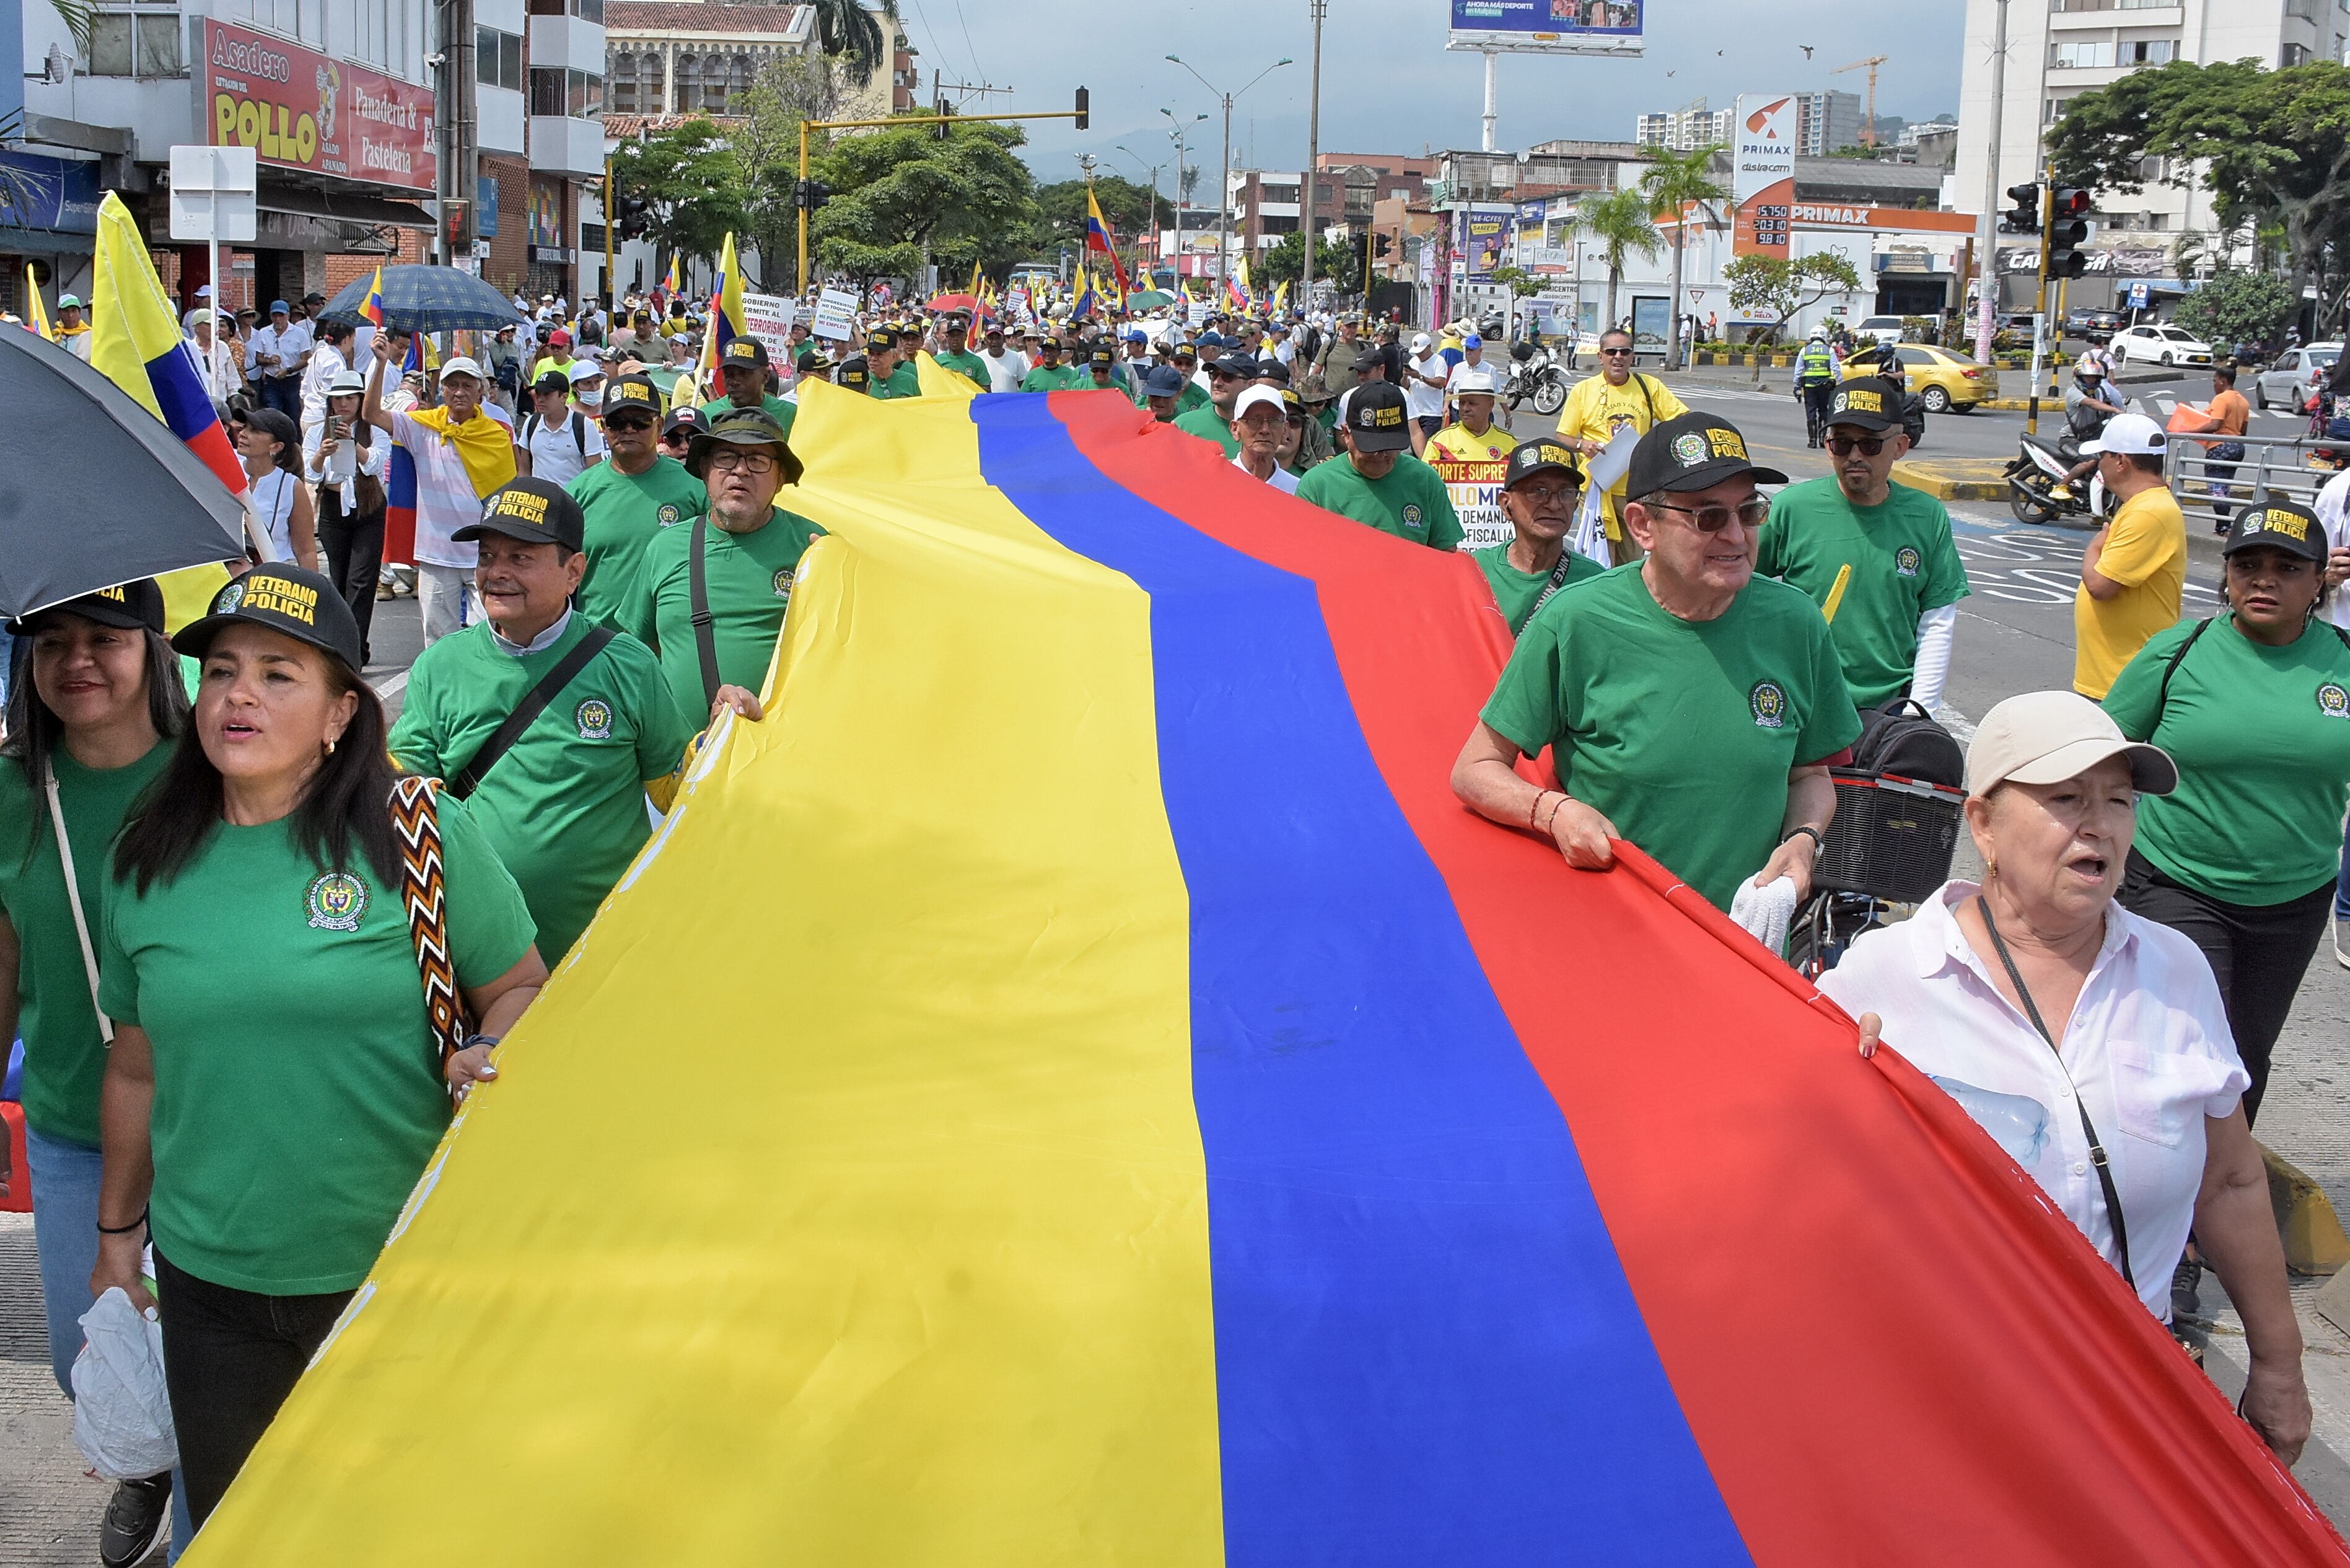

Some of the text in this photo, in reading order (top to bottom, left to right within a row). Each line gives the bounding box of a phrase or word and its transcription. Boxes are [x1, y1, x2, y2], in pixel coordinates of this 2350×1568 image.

[213, 28, 289, 82] Asadero
[356, 86, 416, 130] Panadería &
[216, 94, 317, 164] POLLO
[321, 142, 339, 155] ASADO
[362, 136, 411, 174] Pastelería
[1742, 145, 1790, 154] PRIMAX
[322, 159, 346, 173] APANADO
[1742, 163, 1790, 172] distracom
[1791, 205, 1869, 224] PRIMAX
[742, 298, 780, 309] GOBIERNO
[744, 307, 769, 316] ERMITE
[820, 298, 856, 309] CONGRESISTAS
[826, 322, 847, 330] EMPLEO
[623, 391, 649, 401] POLICIA
[1849, 390, 1882, 402] VETERANO
[1848, 401, 1882, 413] POLICIA
[1377, 417, 1401, 427] POLICIA
[1468, 463, 1507, 481] SUPRE
[502, 491, 548, 511] VETERANO
[1447, 487, 1505, 506] OLOM
[497, 504, 543, 525] POLICIA
[1463, 510, 1511, 524] DEMAND
[2267, 509, 2308, 530] VETERANO
[1467, 529, 1514, 543] FISCALIA
[2264, 521, 2306, 542] POLICIA
[1553, 554, 1569, 582] NIKE
[248, 575, 318, 607] VETERANO
[242, 593, 315, 626] POLICIA
